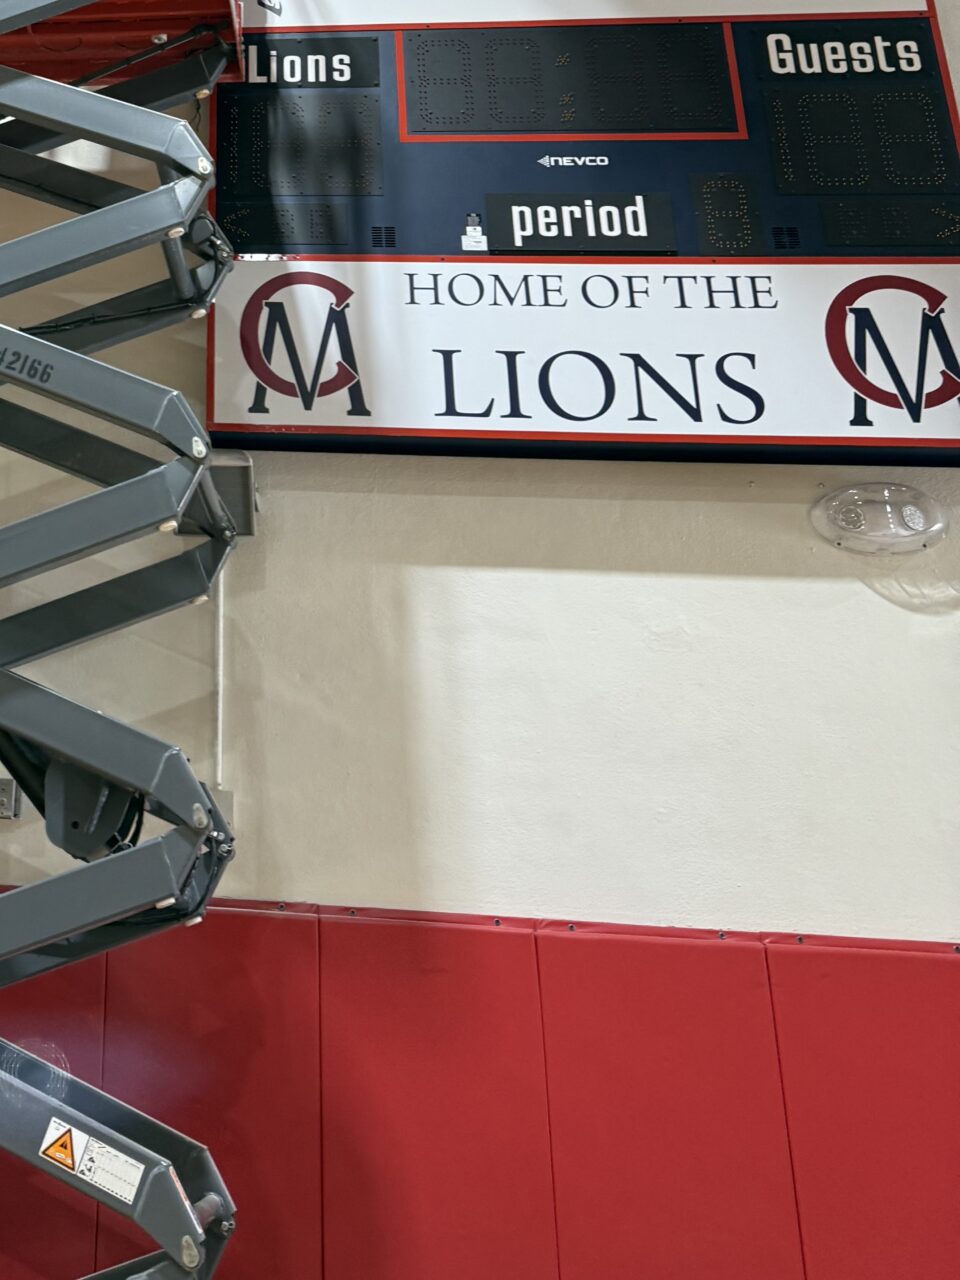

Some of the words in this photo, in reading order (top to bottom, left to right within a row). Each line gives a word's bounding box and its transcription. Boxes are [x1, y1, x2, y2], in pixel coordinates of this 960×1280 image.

[248, 45, 351, 83] Lions
[766, 32, 922, 75] Guests
[550, 156, 609, 166] NEVCO
[511, 195, 648, 247] period
[403, 272, 568, 308] HOME
[581, 274, 650, 309] OF
[662, 275, 779, 309] THE
[432, 349, 766, 425] LIONS
